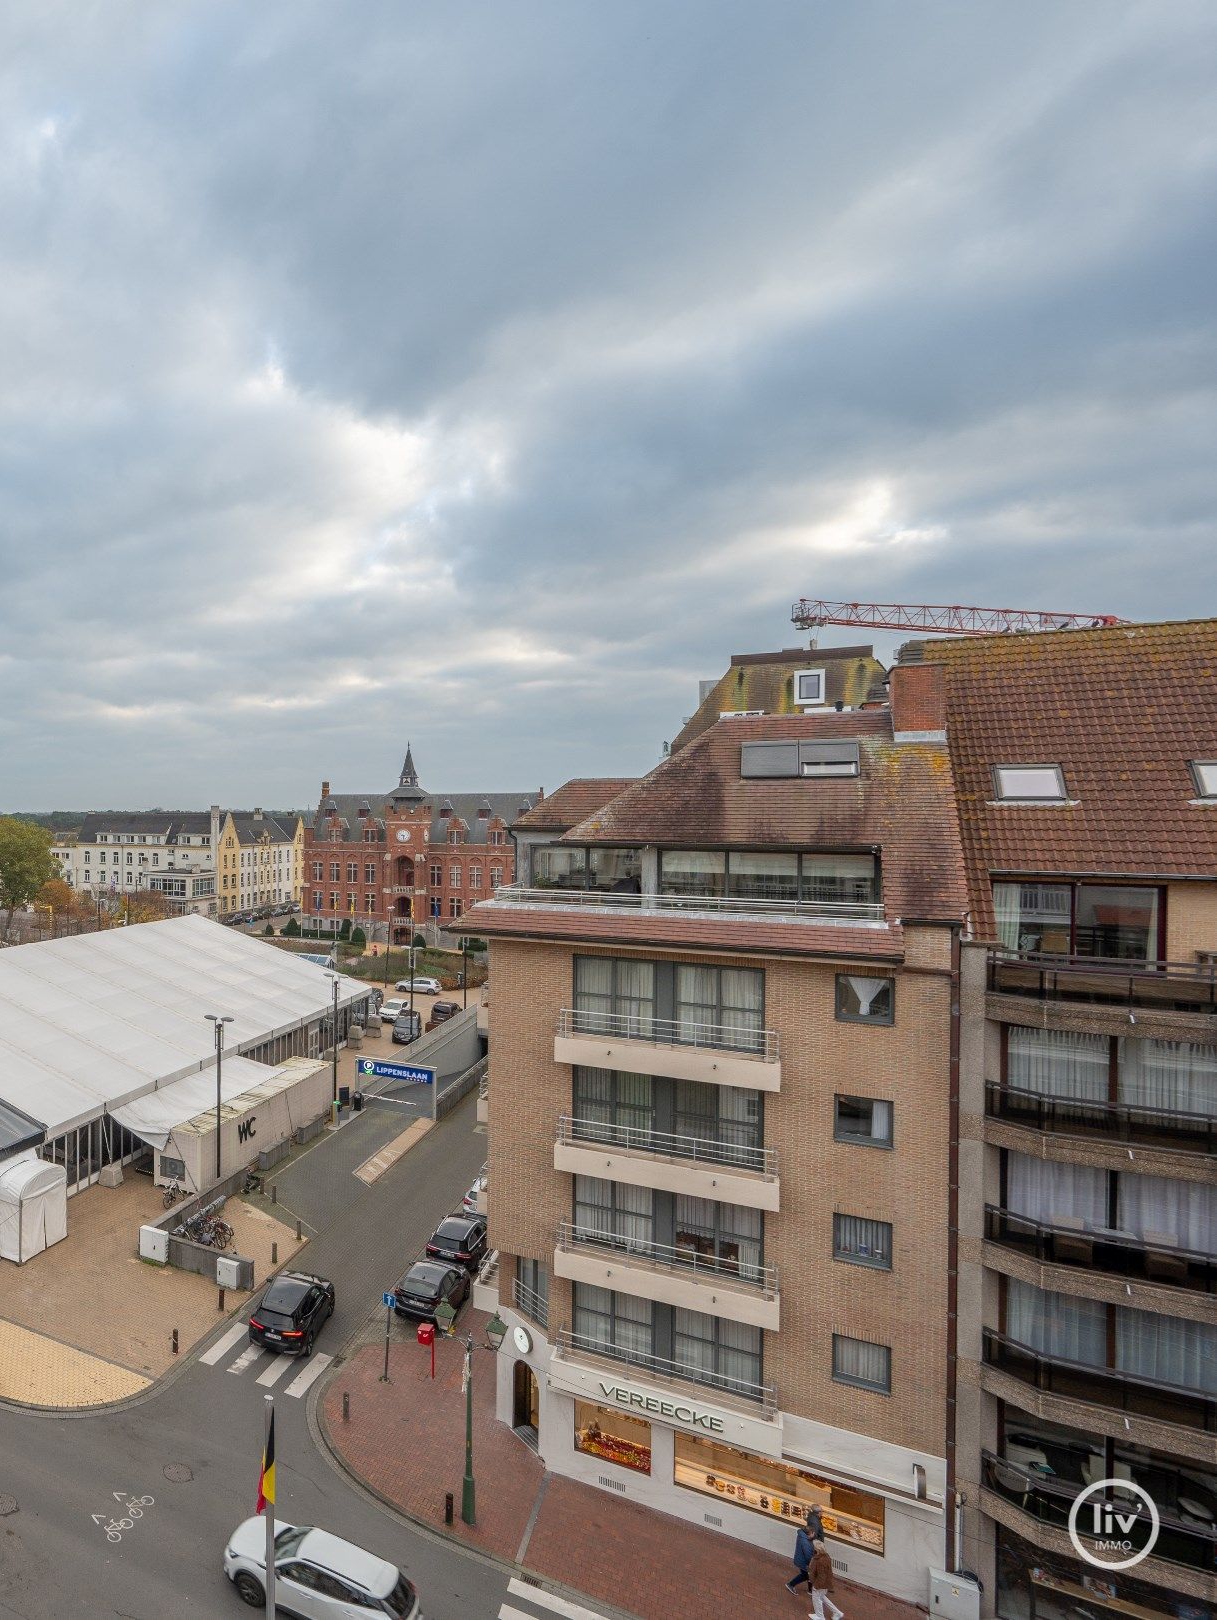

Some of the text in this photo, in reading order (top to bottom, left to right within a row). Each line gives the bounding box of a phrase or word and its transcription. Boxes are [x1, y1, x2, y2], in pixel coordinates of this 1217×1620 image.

[376, 1066, 428, 1080] LIPPENSLAAN
[238, 1116, 257, 1144] WC
[599, 1382, 724, 1433] VEREECKE
